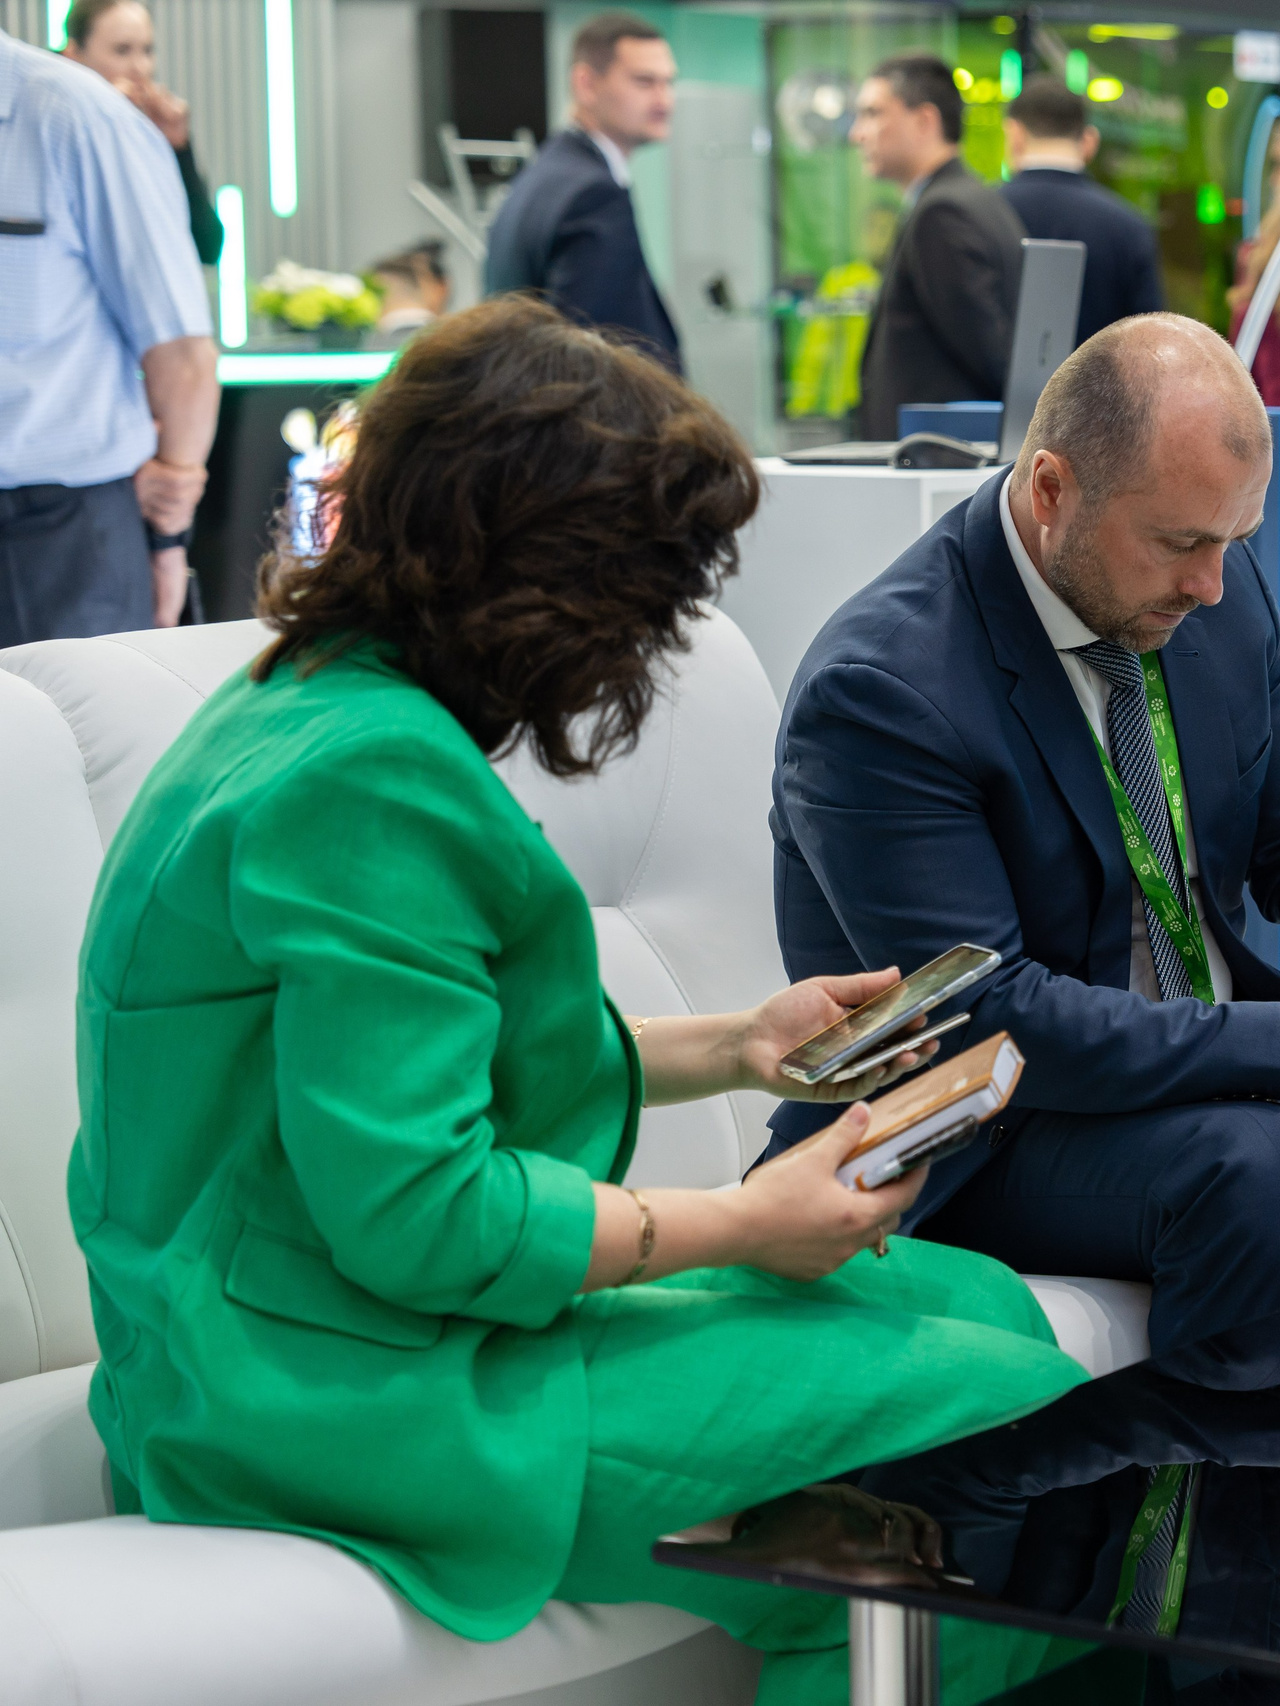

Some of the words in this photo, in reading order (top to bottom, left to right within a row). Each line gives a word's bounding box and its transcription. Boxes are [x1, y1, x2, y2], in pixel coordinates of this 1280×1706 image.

[1103, 764, 1118, 790] INNOPROM
[1161, 758, 1170, 785] INNOPROM
[1118, 811, 1131, 835] INDUSTRIAL
[1146, 853, 1160, 879] INNOPROM
